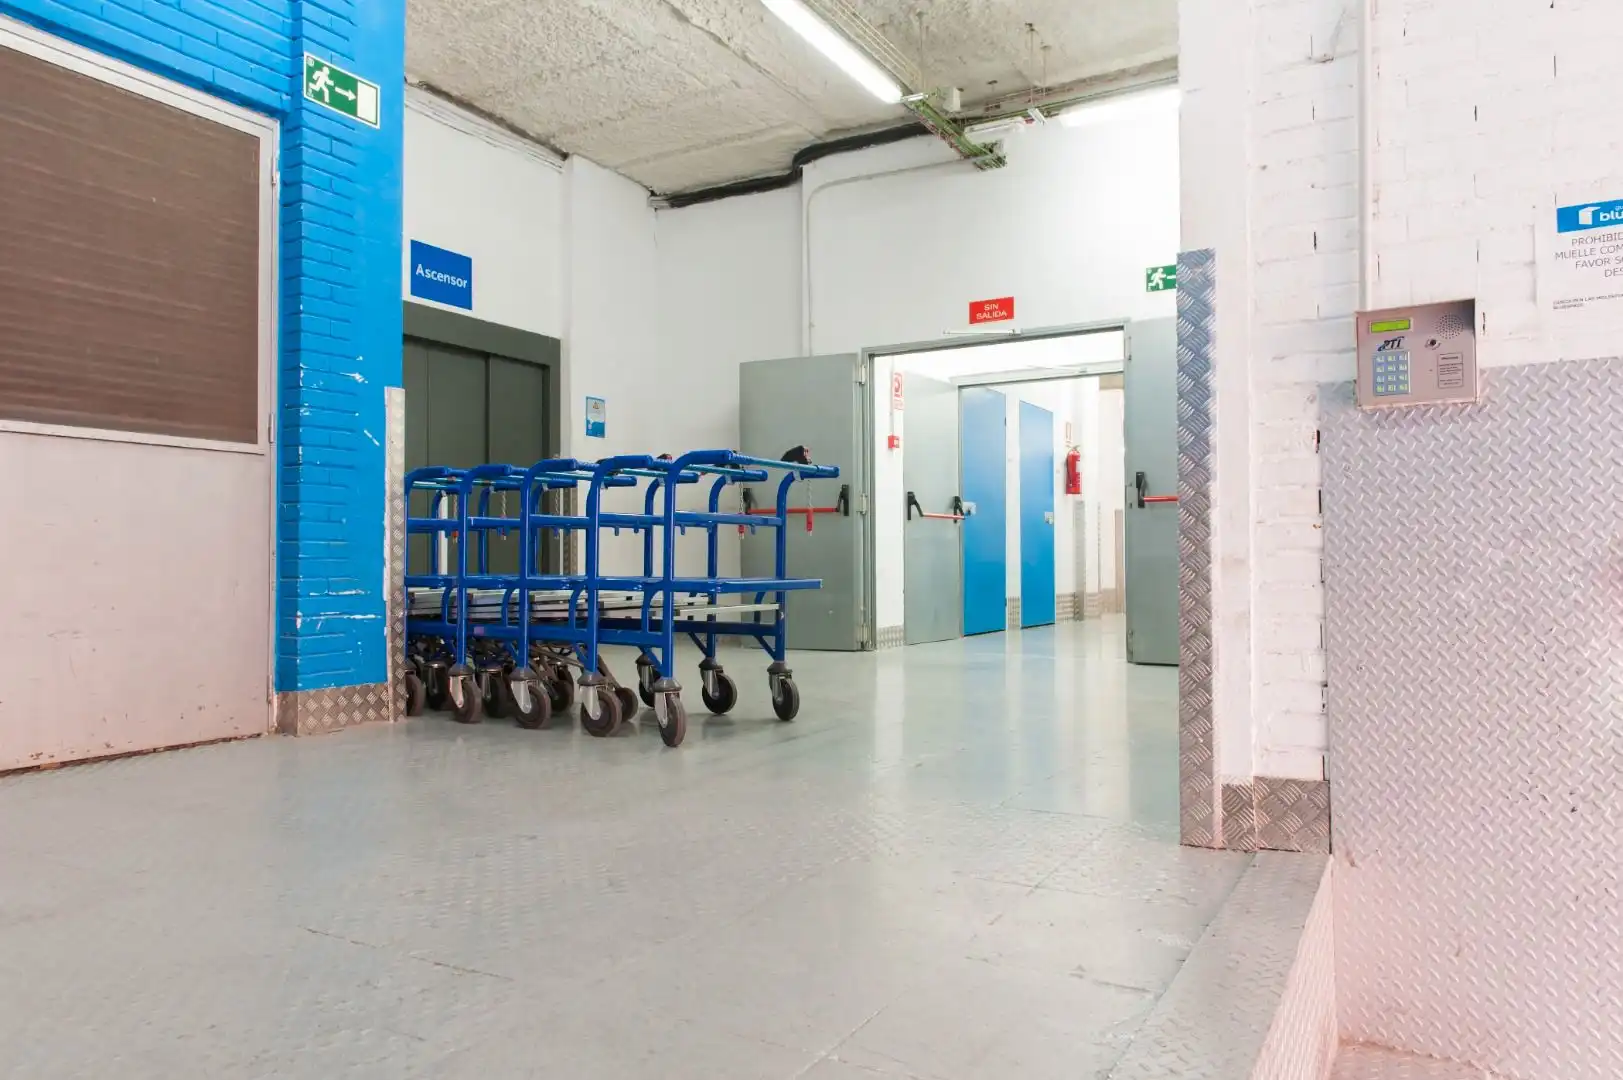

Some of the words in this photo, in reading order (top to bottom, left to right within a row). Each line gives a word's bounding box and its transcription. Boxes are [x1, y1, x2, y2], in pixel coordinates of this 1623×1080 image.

[1555, 247, 1597, 261] MUELLE
[1575, 257, 1611, 270] FAVOR
[415, 263, 468, 289] Ascensor
[984, 303, 999, 311] SIN
[976, 310, 1008, 320] SALIDA
